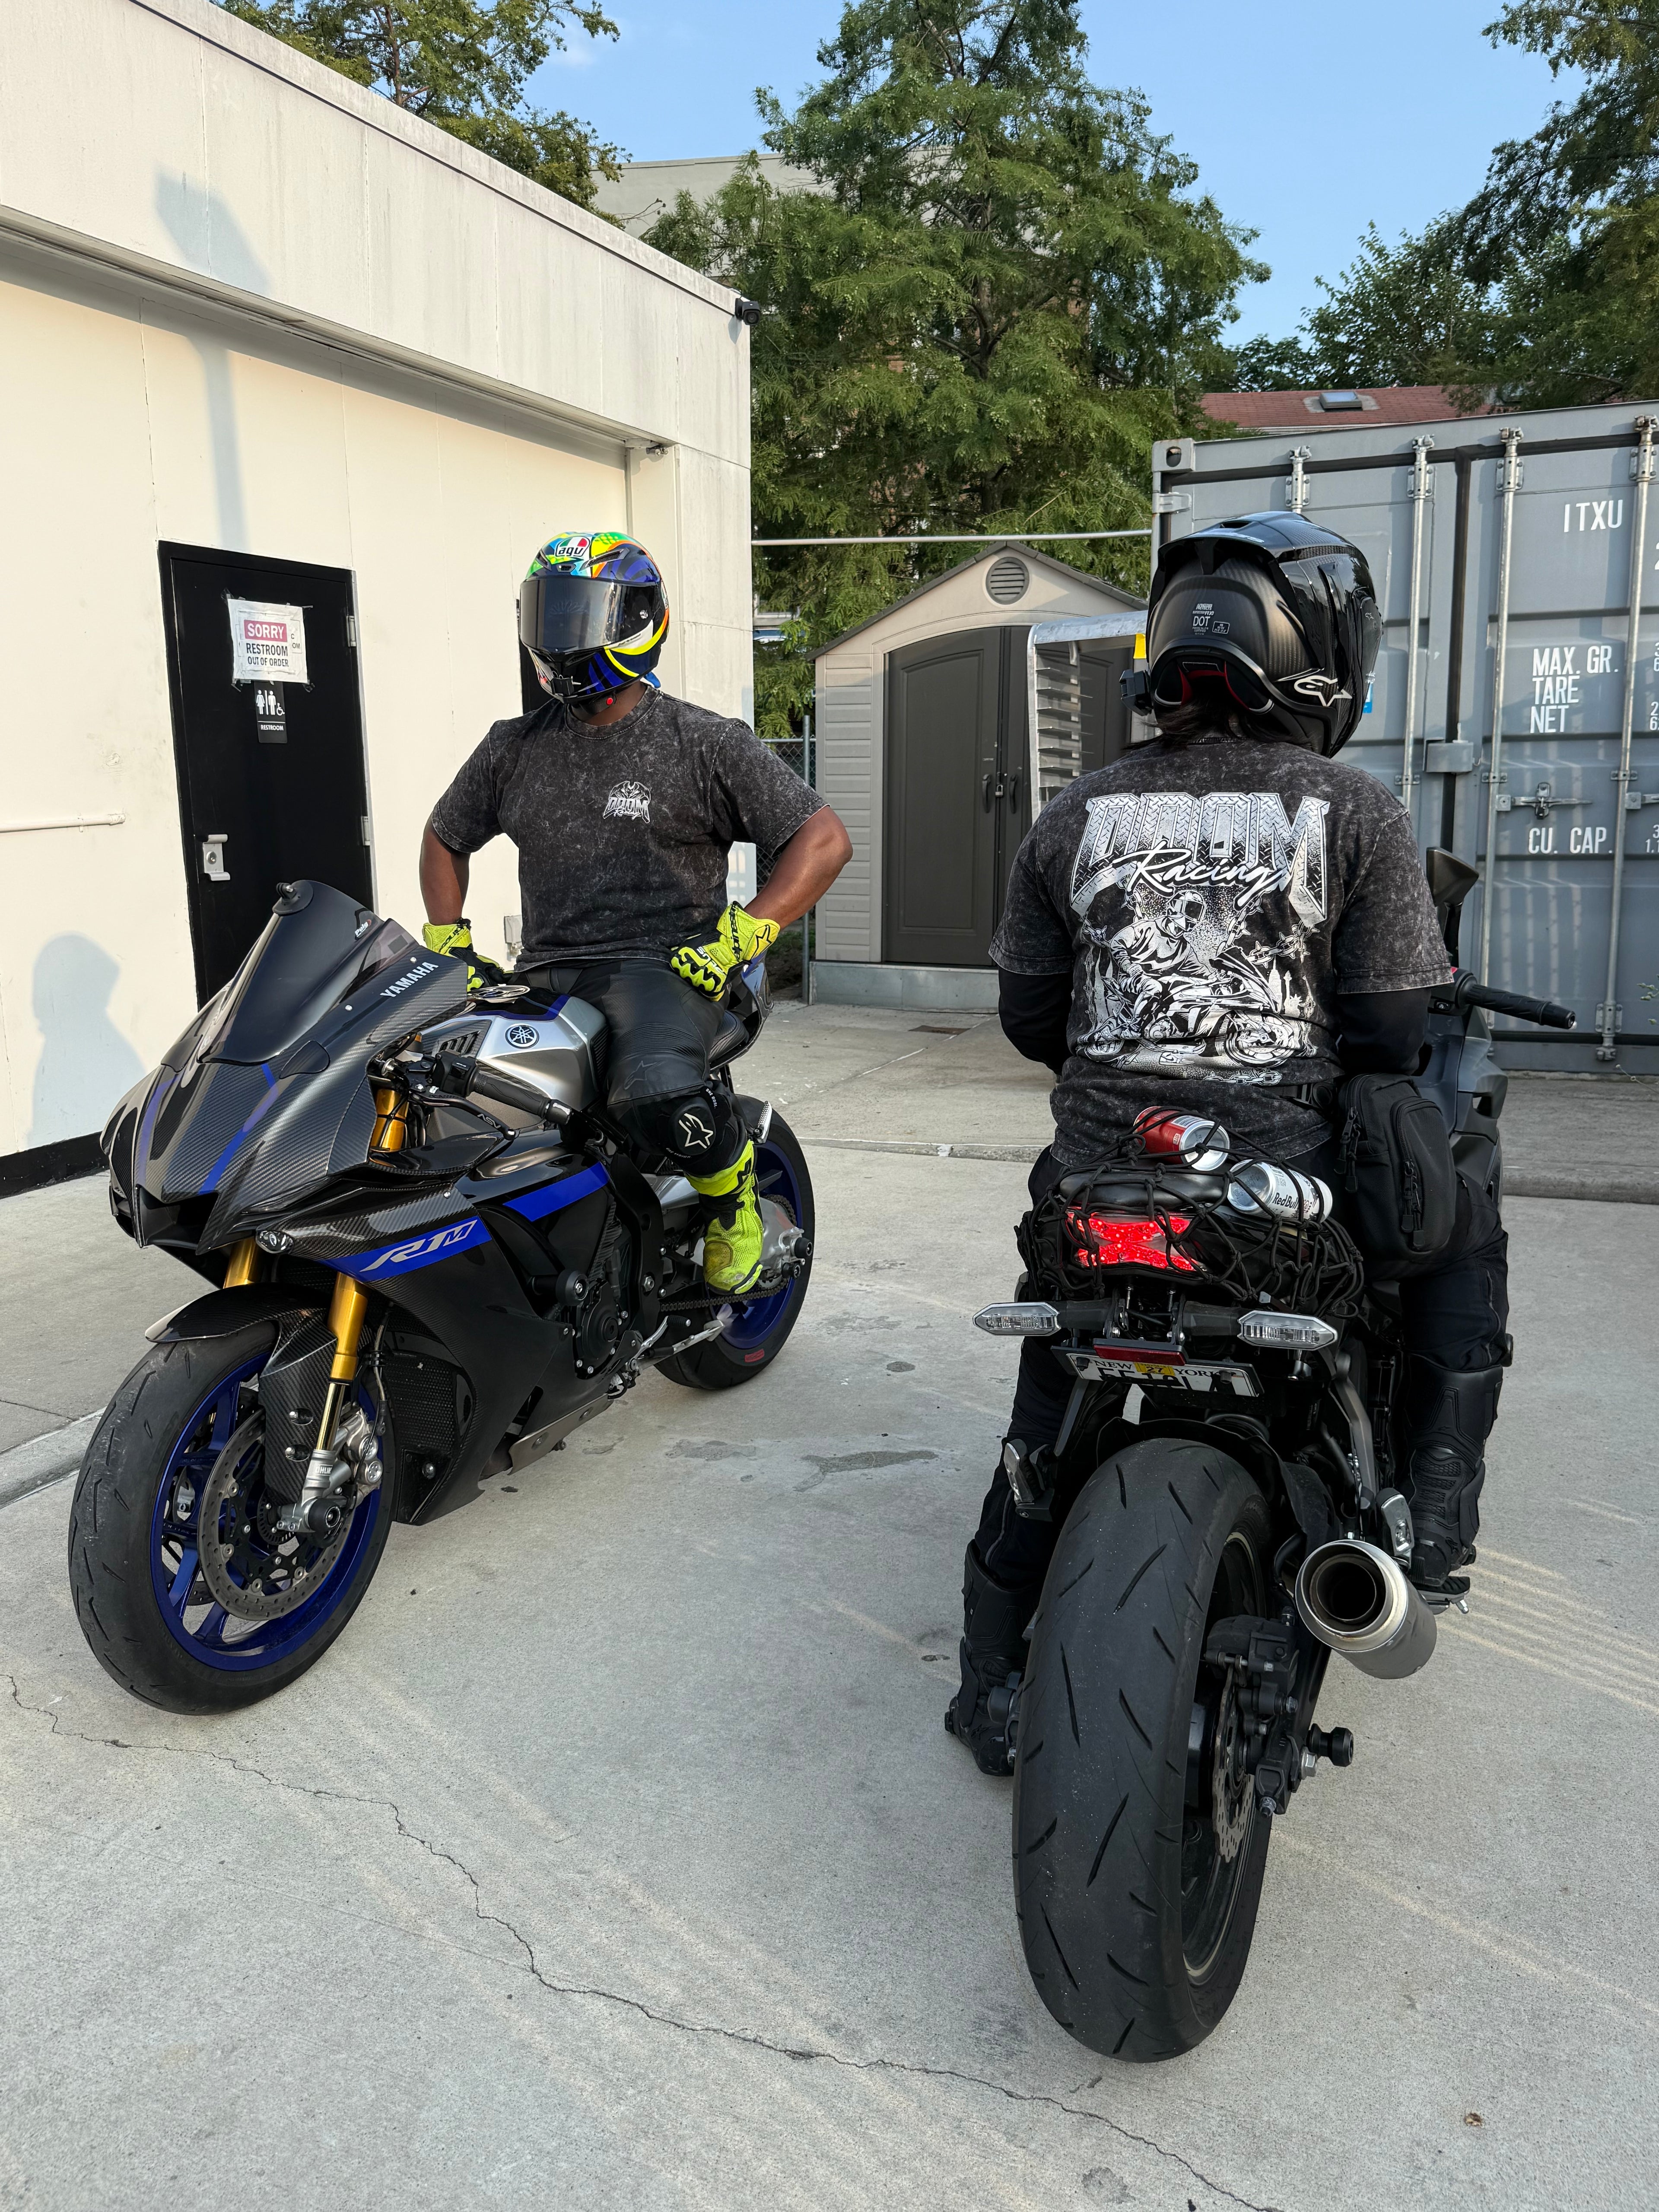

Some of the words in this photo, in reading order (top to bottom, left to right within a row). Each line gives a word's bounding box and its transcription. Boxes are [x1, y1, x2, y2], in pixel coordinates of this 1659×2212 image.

[1564, 499, 1623, 533] ITXU
[558, 547, 584, 556] agv
[248, 623, 284, 639] SORRY
[1193, 616, 1211, 626] DOT
[246, 643, 288, 656] RESTROOM
[248, 656, 259, 665] OUT
[261, 657, 268, 666] OF
[270, 658, 289, 667] ORDER
[1532, 646, 1580, 676] MAX.
[1587, 645, 1618, 674] GR.
[1532, 675, 1580, 705] TARE
[1530, 705, 1569, 734] NET
[603, 797, 650, 823] DOOM
[1529, 827, 1558, 854] CU.
[1570, 827, 1613, 854] CAP.
[1069, 792, 1330, 928] DOOM
[1111, 838, 1279, 908] Racing
[355, 922, 369, 937] Puig
[380, 962, 439, 998] YAMAHA
[477, 1113, 501, 1128] ASV
[359, 1219, 477, 1272] R1M
[1093, 1360, 1132, 1370] NEW
